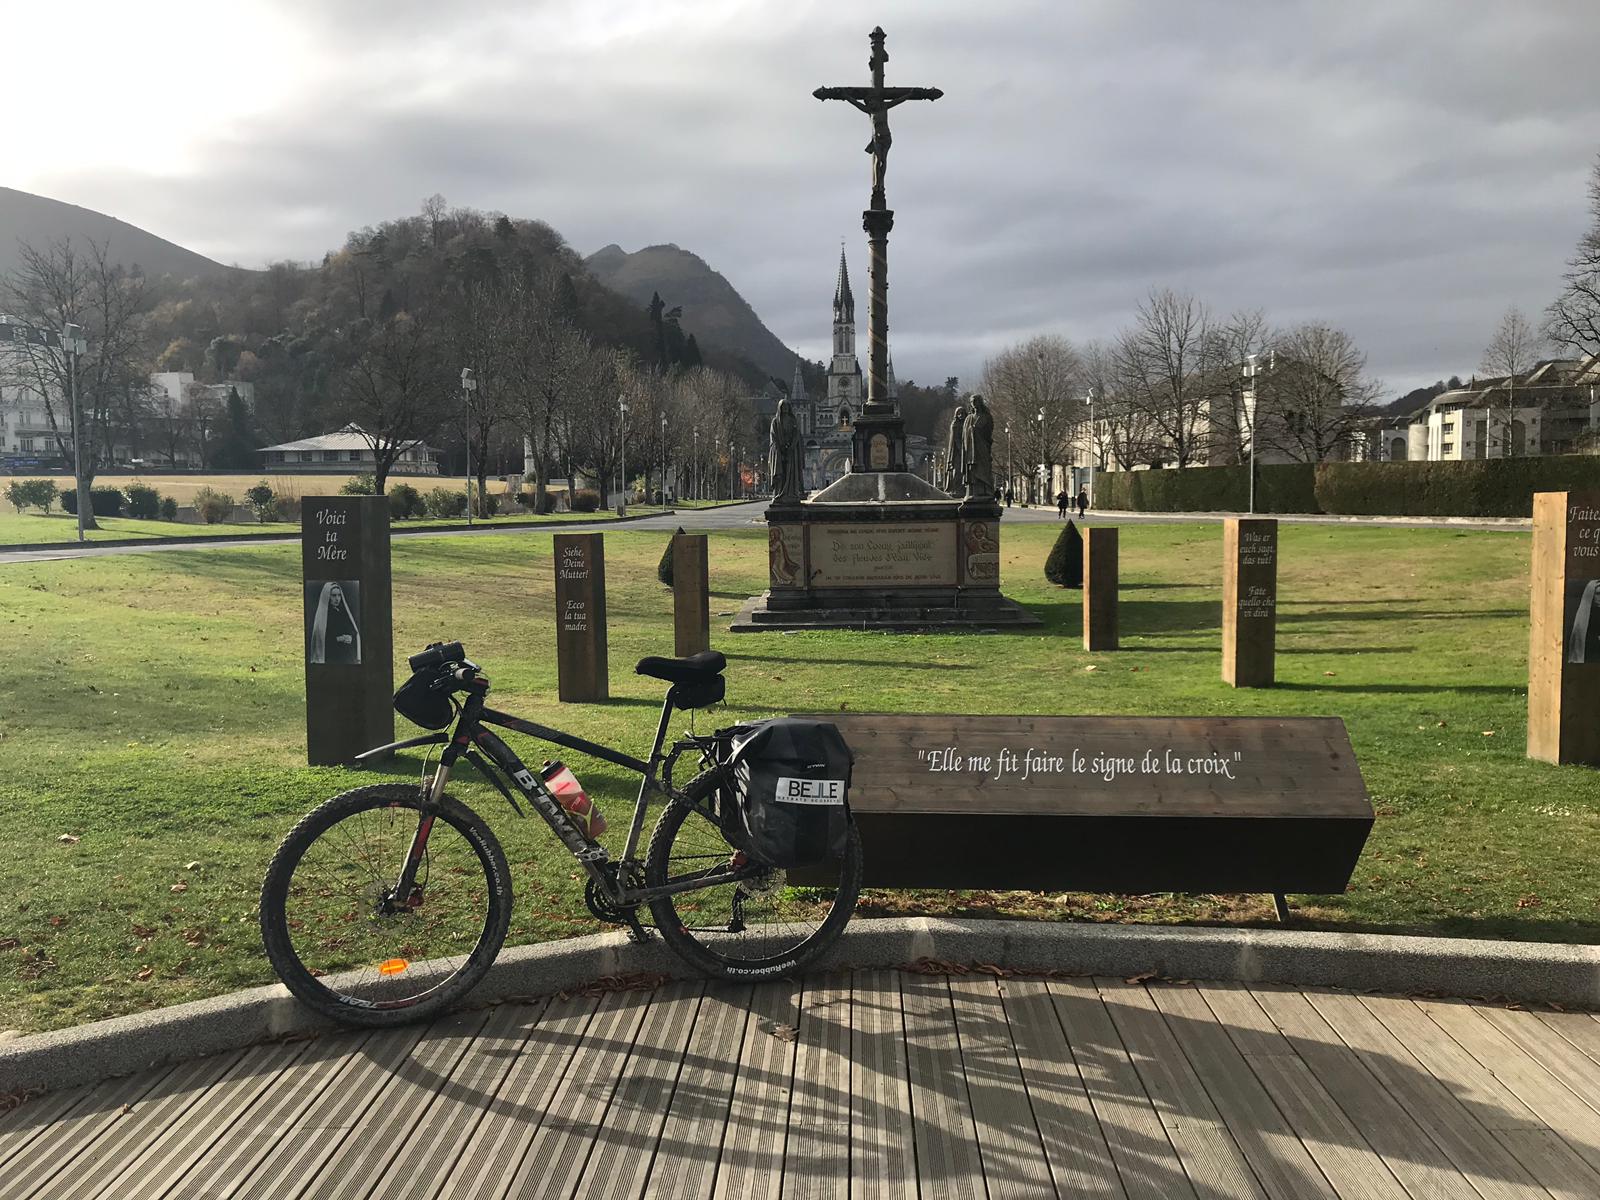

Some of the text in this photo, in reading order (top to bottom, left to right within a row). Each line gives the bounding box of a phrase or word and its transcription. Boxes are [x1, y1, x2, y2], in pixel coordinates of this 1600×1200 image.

[316, 508, 346, 525] Voici
[325, 531, 337, 542] ta
[1244, 532, 1262, 542] Was
[1579, 528, 1591, 539] ce
[317, 544, 347, 560] Mère
[563, 546, 584, 557] Siehe,
[1573, 546, 1599, 557] vous
[563, 558, 585, 568] Deine
[1243, 556, 1256, 565] das
[560, 569, 589, 579] Mutter!
[1248, 585, 1266, 597] Fate
[566, 600, 585, 609] Ecco
[1239, 596, 1274, 609] quello che
[564, 610, 586, 620] la tua
[565, 621, 587, 631] madre
[918, 747, 1241, 782] "Elle me fit faire le signe de la croix"
[469, 826, 503, 896] VeeRubber.co.th
[727, 959, 797, 975] VeeRubber.co.th
